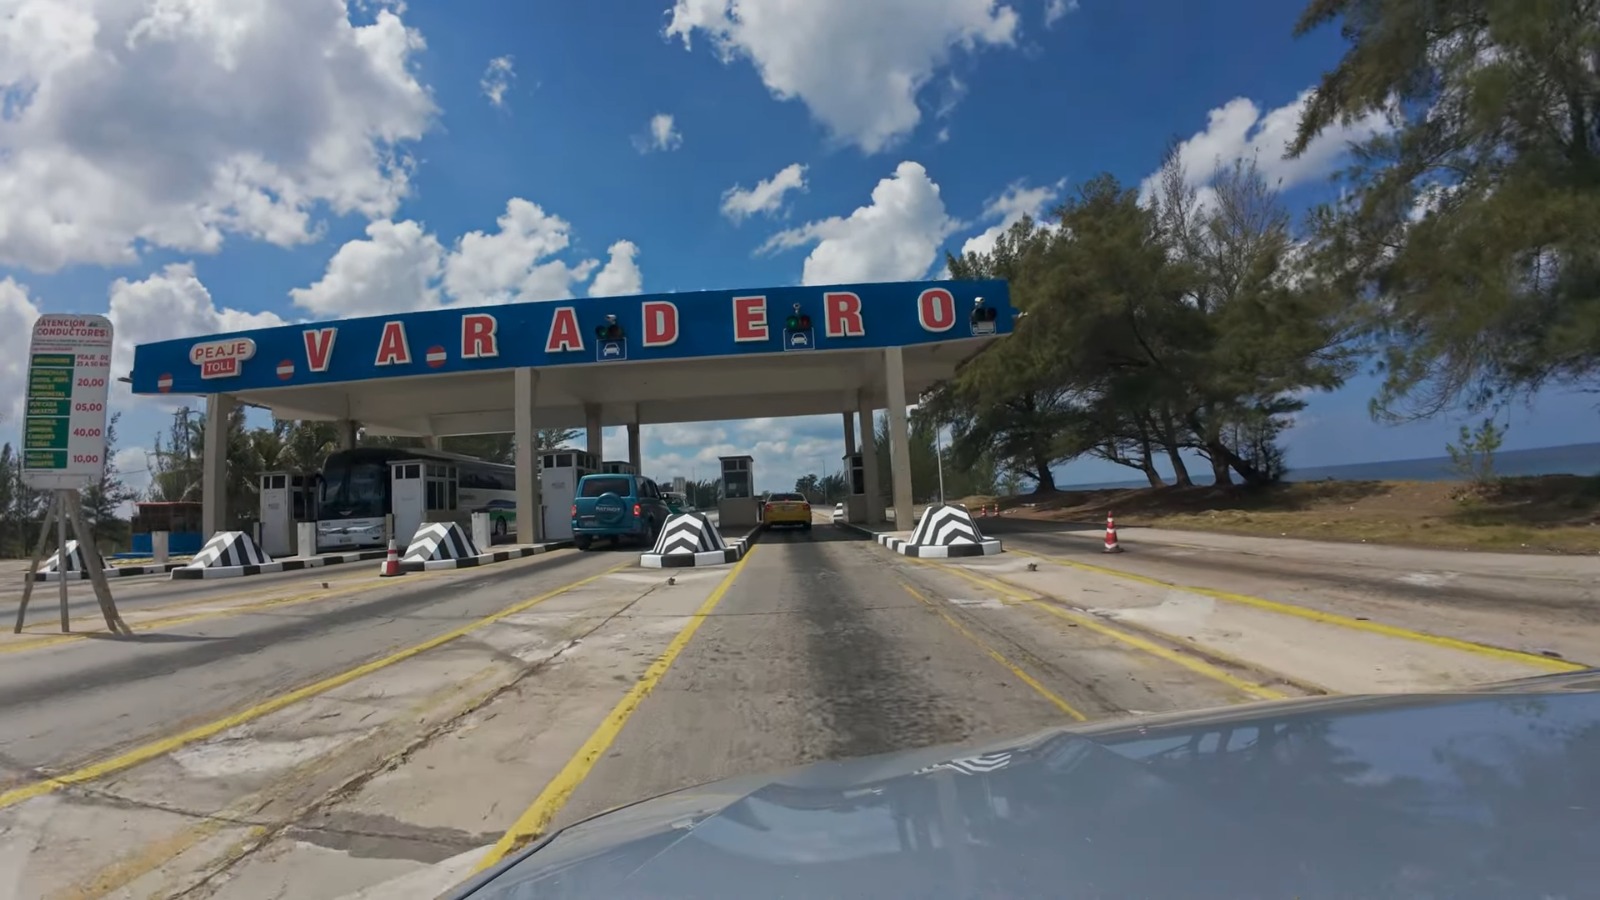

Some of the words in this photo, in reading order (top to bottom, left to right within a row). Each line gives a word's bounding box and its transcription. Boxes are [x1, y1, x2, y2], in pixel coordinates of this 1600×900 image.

[195, 342, 247, 361] PEAJE
[206, 361, 233, 372] TOLL
[77, 378, 104, 388] 20,00
[75, 403, 102, 412] 05,00
[73, 428, 101, 437] 40,00
[73, 454, 99, 464] 10,00
